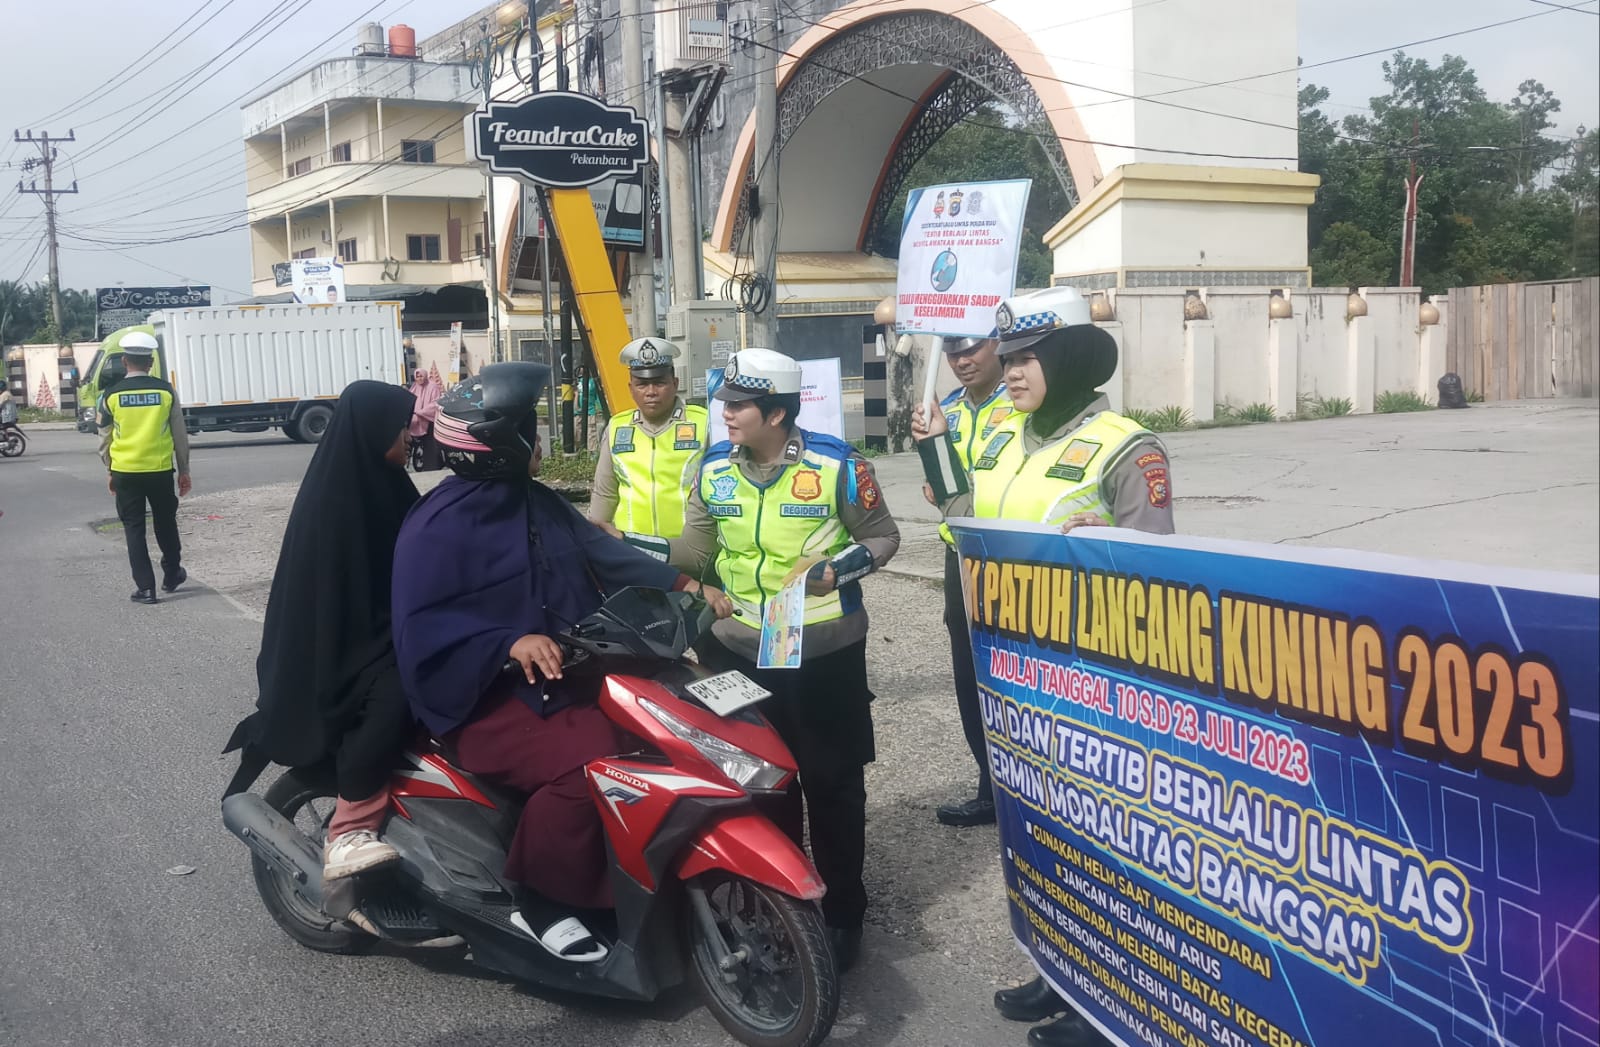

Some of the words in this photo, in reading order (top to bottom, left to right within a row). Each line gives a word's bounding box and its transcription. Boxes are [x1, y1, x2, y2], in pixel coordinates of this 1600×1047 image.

[571, 153, 628, 167] Pekanbaru
[914, 306, 966, 319] KESELAMATAN
[120, 394, 160, 406] POLISI
[782, 505, 826, 515] REGIDENT
[983, 560, 1073, 645] PATUH
[1076, 571, 1214, 686] LANCANG
[1220, 596, 1388, 733] KUNING
[1397, 633, 1565, 778] 2023
[990, 648, 1038, 689] MULAI
[1038, 660, 1113, 716] TANGGAL
[1116, 684, 1139, 722] 10
[1173, 703, 1199, 742] 23
[1200, 712, 1246, 761] JULI
[1250, 729, 1310, 785] 2023
[604, 767, 652, 792] HONDA
[987, 743, 1045, 809] ERMIN
[1046, 773, 1193, 884] MORALITAS
[1006, 703, 1051, 752] DAN
[1055, 723, 1146, 795] TERTIB
[1152, 762, 1298, 861] BERLALU
[1308, 822, 1464, 938] LINTAS
[1021, 879, 1055, 921] JANGAN
[1055, 907, 1129, 977] BERBONCENG
[1129, 962, 1170, 1006] LEBIH
[1171, 990, 1208, 1034] DARI
[1032, 824, 1082, 869] GUNAKAN
[1083, 853, 1116, 892] HELM
[1117, 874, 1151, 910] SAAT
[1152, 895, 1271, 980] MENGENDARAI
[1036, 934, 1073, 982] JANGAN
[1043, 876, 1115, 941] BERKENDARA
[1115, 926, 1178, 984] MELEBIHI
[1180, 969, 1232, 1018] BATAS
[1061, 866, 1108, 910] JANGAN
[1108, 895, 1177, 954] MELAWAN
[1179, 940, 1222, 981] ARUS
[1090, 961, 1149, 1017] DIBAWAH
